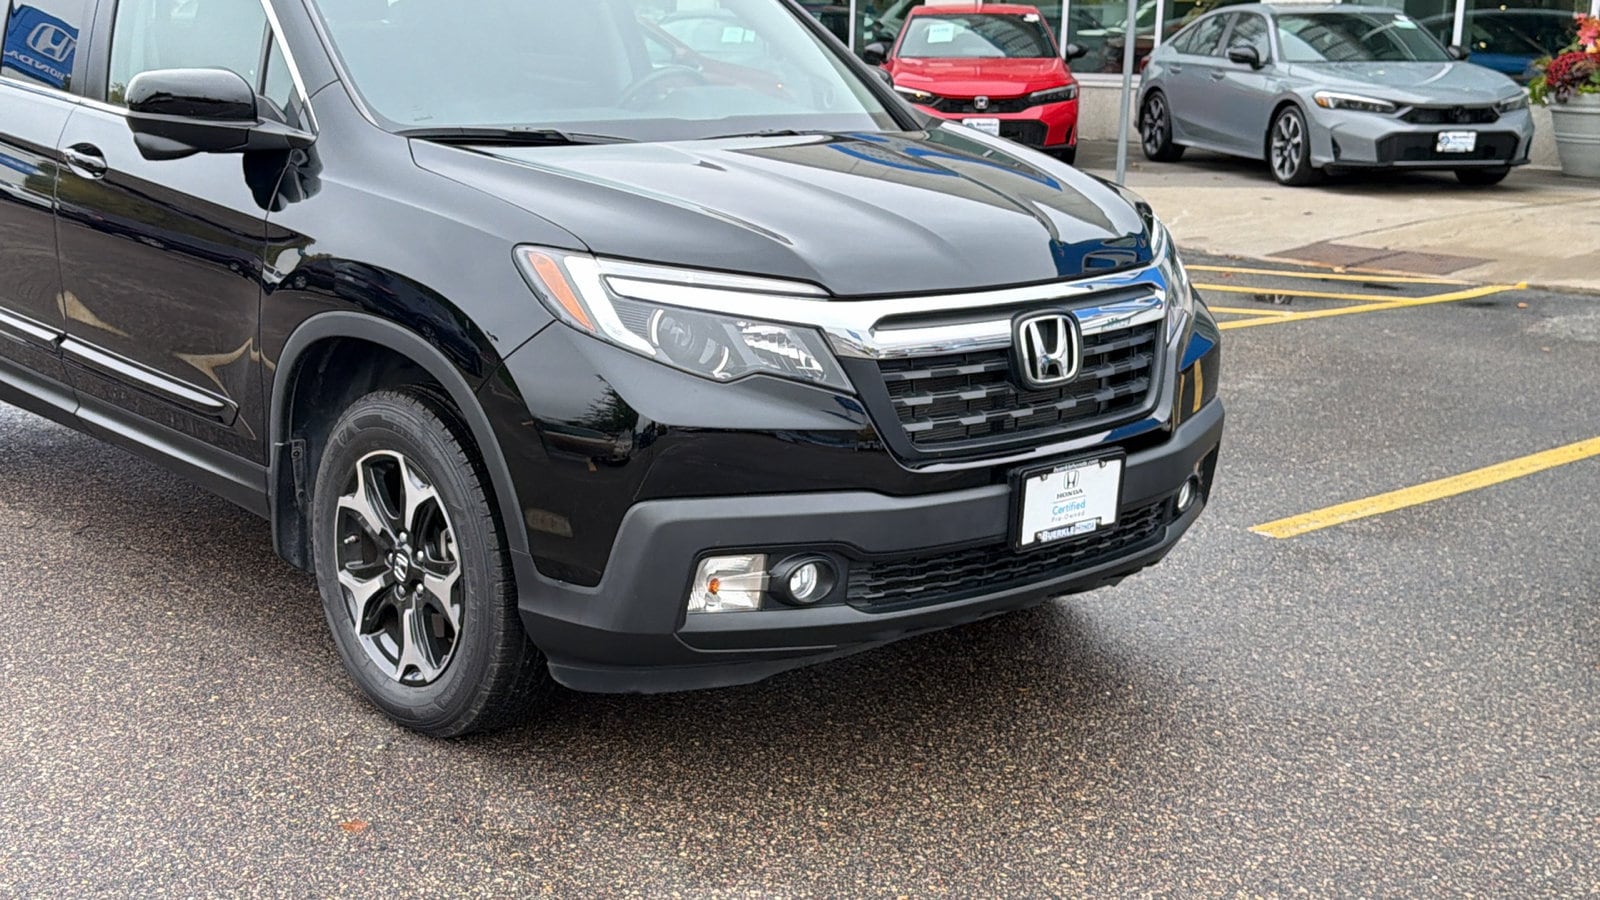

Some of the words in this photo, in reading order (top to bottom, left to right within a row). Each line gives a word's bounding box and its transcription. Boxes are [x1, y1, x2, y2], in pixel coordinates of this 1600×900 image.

[1056, 488, 1083, 499] HONDA
[1052, 498, 1086, 515] Certified
[1051, 511, 1085, 523] Pre-Owned
